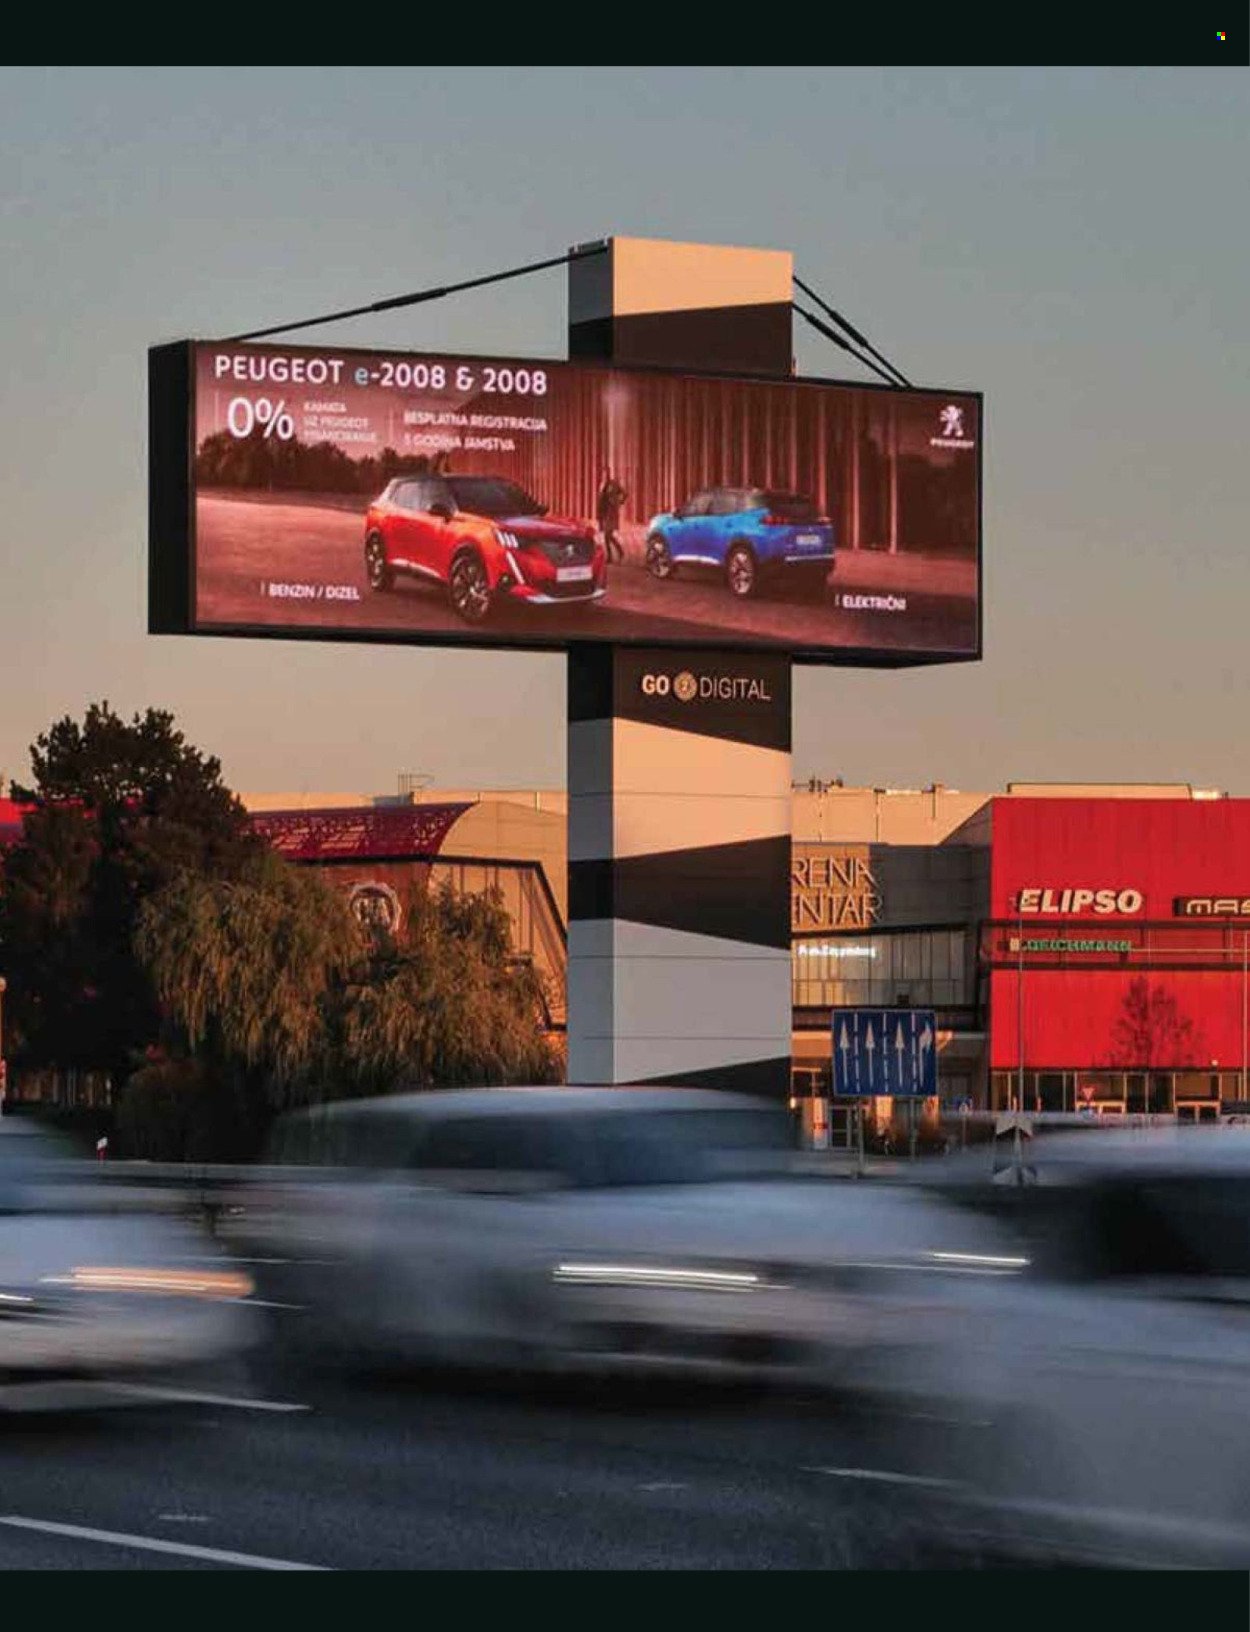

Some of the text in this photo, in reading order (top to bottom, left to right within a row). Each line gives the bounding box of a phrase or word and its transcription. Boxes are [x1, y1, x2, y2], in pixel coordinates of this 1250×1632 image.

[215, 355, 547, 395] PEUGEOT e-2008 & 2008
[227, 396, 294, 440] 0%
[404, 410, 547, 432] BESPLATNA REGISTRACIJA
[269, 583, 315, 598] BENZIN
[642, 674, 772, 701] GO DIGITAL
[1018, 888, 1143, 914] ELIPSO
